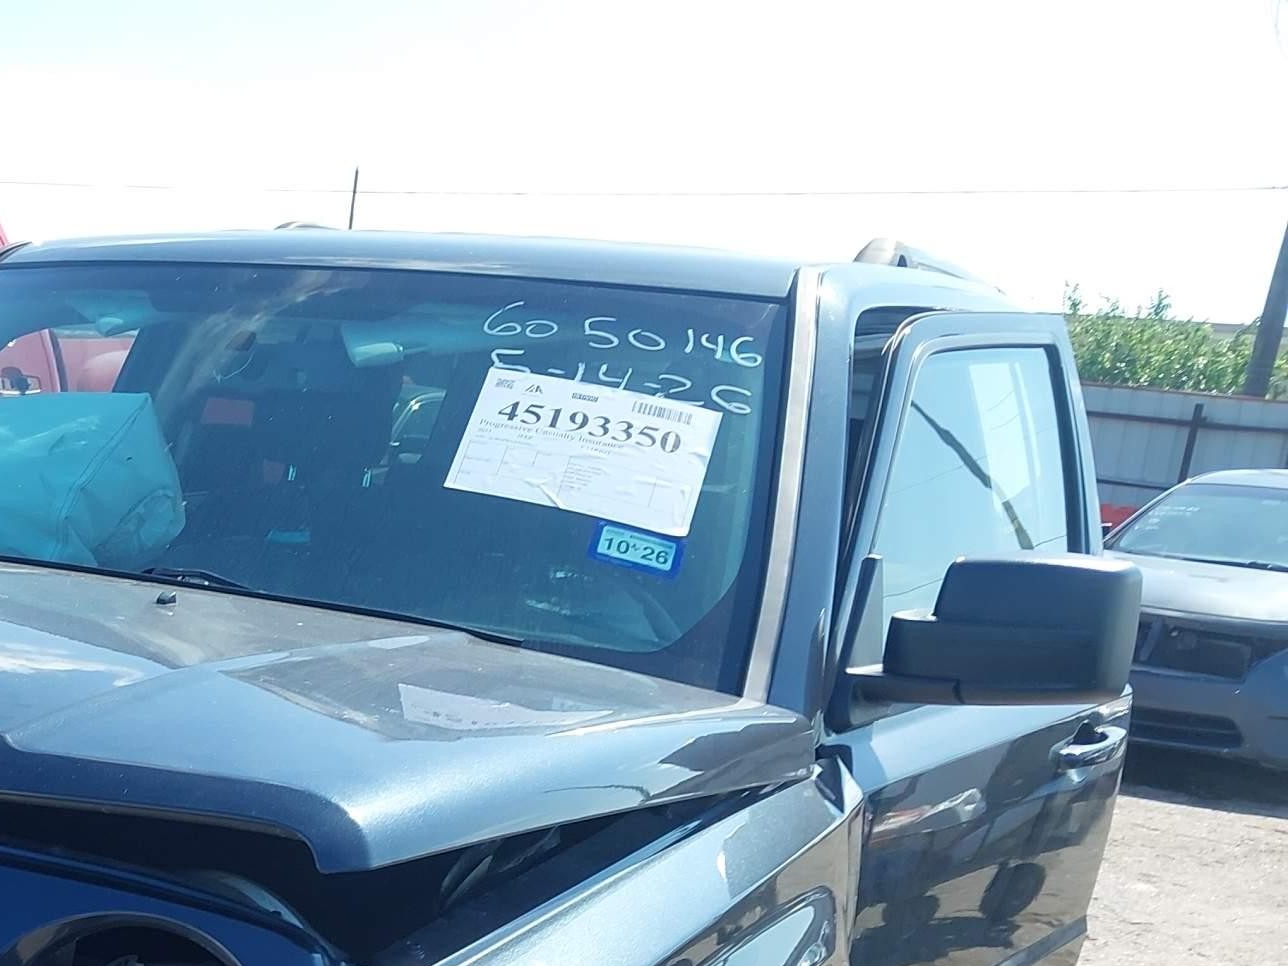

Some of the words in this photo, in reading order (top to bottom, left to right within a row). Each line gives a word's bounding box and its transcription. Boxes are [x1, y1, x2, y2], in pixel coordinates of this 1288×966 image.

[479, 417, 534, 434] Progressive
[497, 400, 682, 454] 45193350
[604, 536, 630, 555] 10
[640, 546, 669, 565] 26
